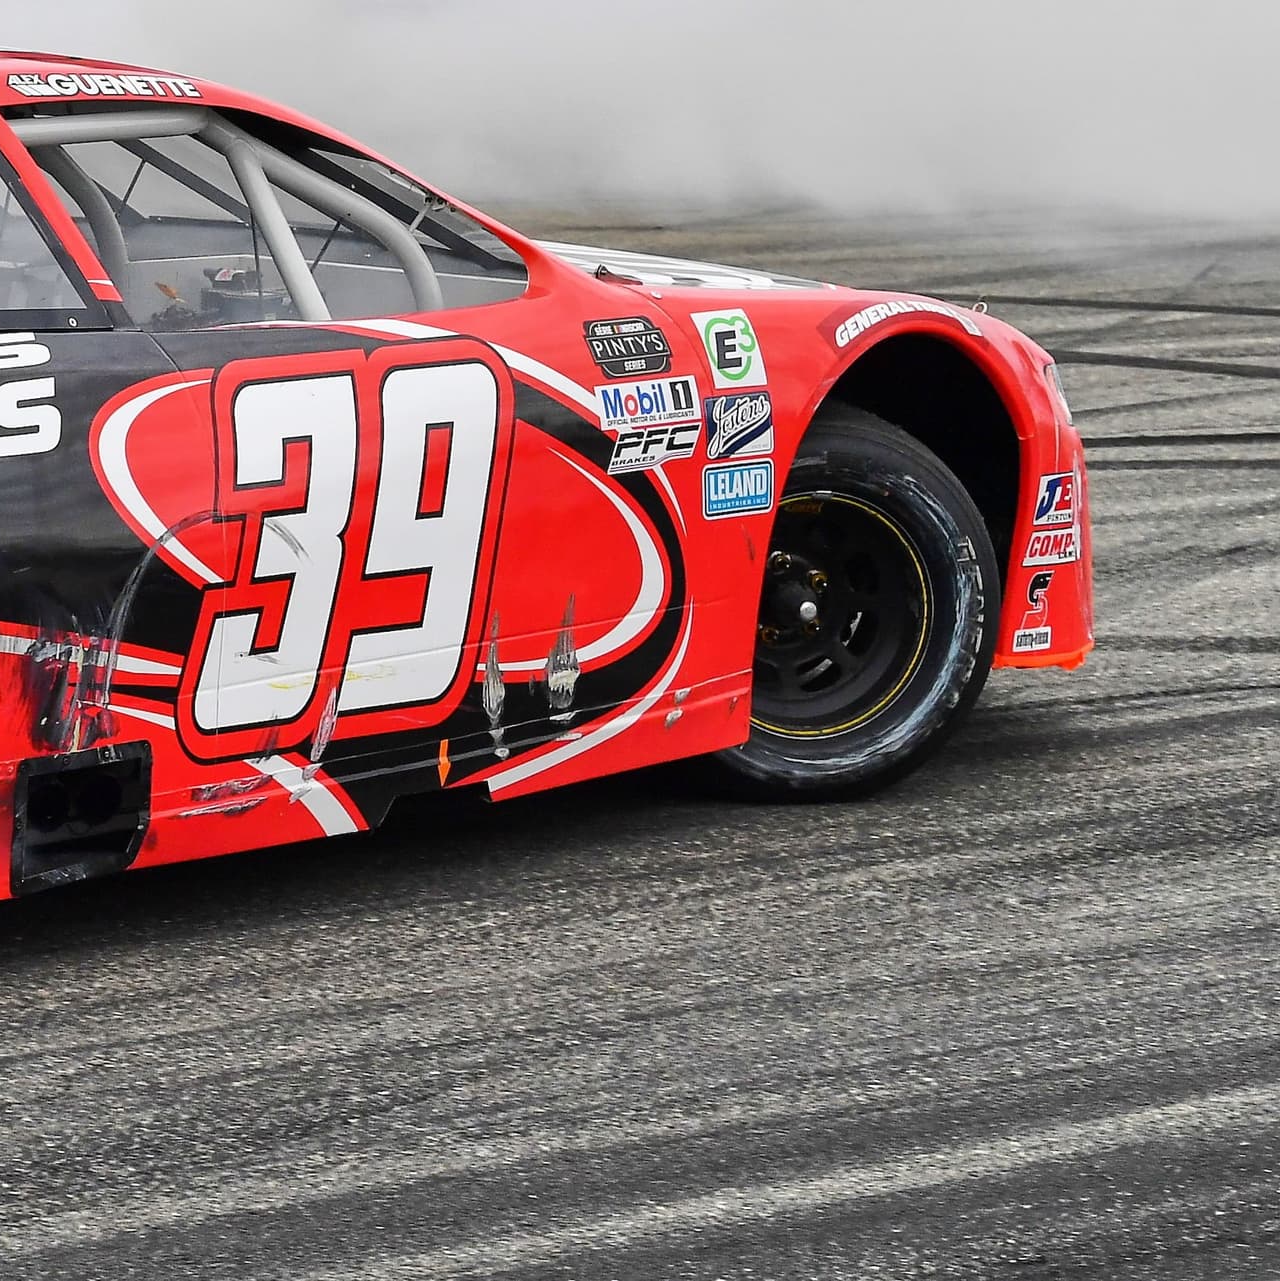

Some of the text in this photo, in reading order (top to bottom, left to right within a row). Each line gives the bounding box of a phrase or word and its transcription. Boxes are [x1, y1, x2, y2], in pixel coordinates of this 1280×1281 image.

[7, 73, 204, 98] ALEX GUENETTE
[835, 301, 912, 348] GENERAL
[592, 334, 664, 358] PINTY'S
[601, 381, 690, 419] Mobil 1
[614, 424, 700, 458] PFC
[707, 395, 772, 459] Jostens
[612, 455, 656, 467] BRAKES
[708, 468, 768, 501] LELAND
[194, 362, 499, 730] 39
